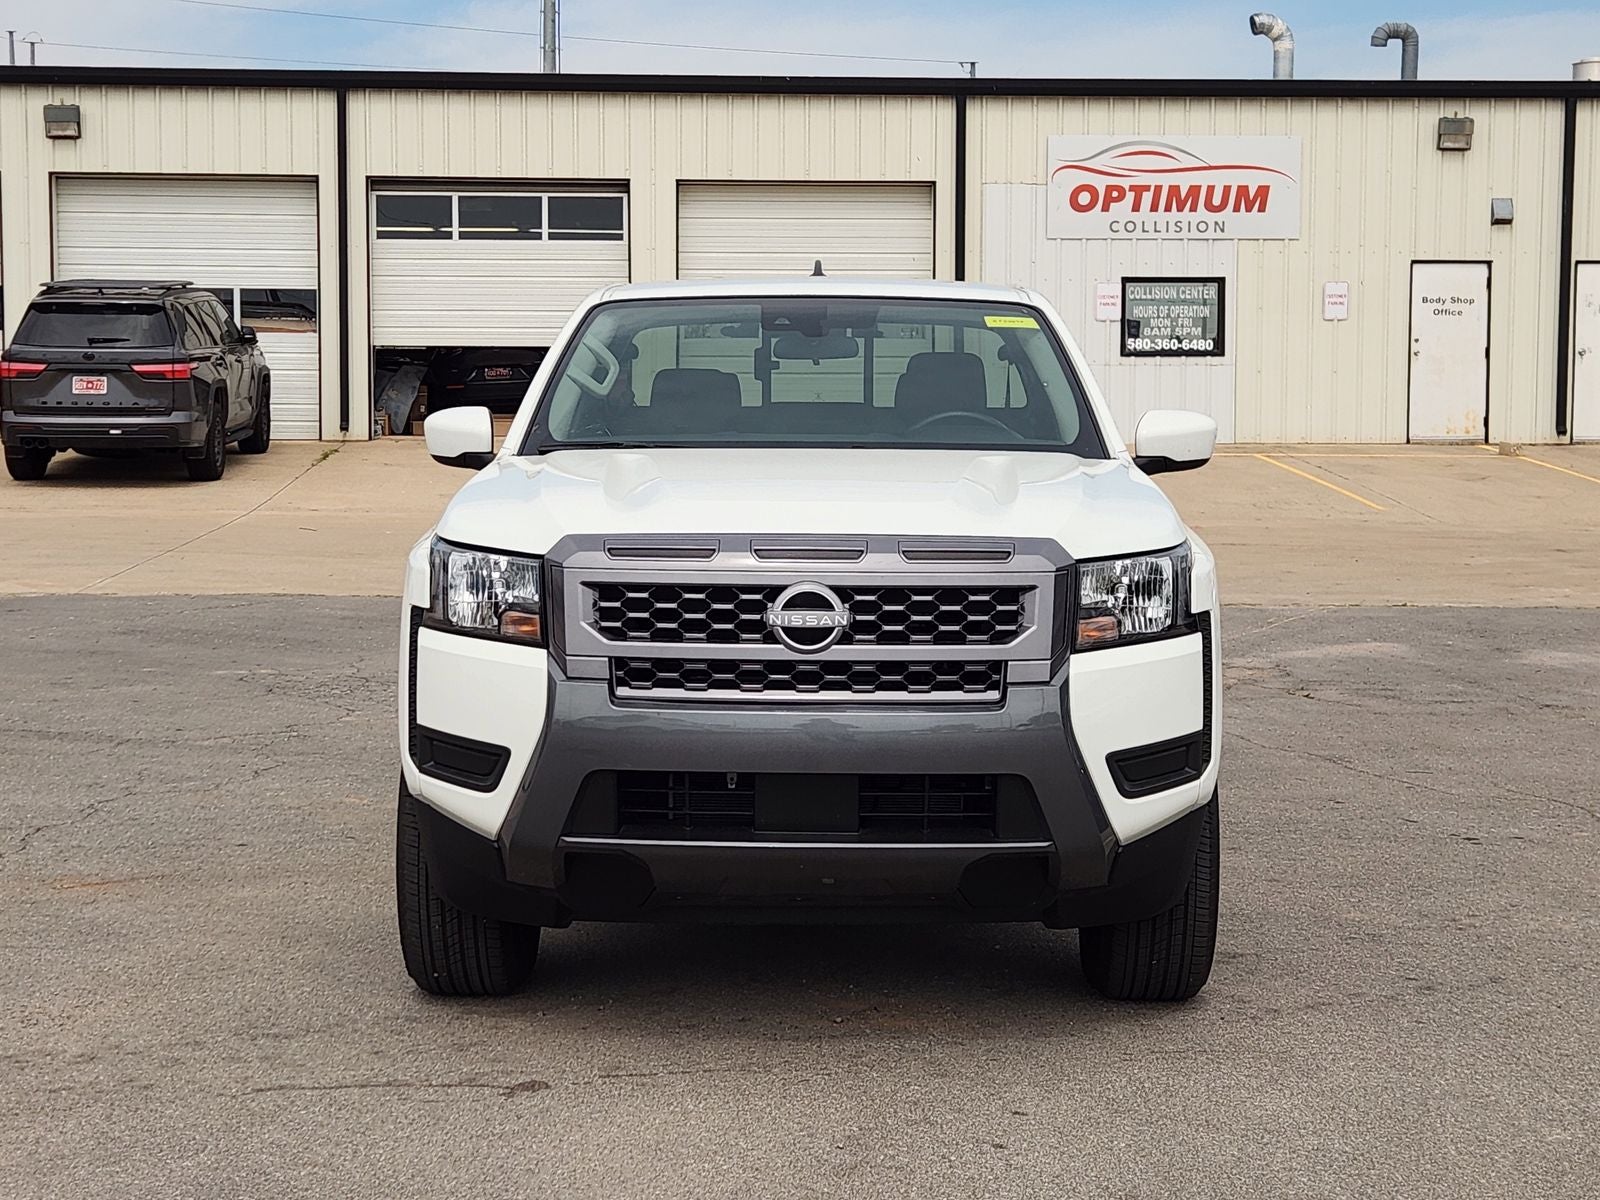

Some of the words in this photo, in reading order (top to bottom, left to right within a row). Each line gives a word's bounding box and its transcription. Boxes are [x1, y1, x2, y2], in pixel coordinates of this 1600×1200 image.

[1069, 183, 1271, 214] OPTIMUM
[1109, 220, 1226, 234] COLLISION
[1128, 286, 1177, 299] COLLISION
[1179, 286, 1216, 299] CENTER
[1422, 296, 1447, 305] Body
[1450, 296, 1475, 305] Shop
[1133, 305, 1158, 318] HOURS
[1159, 305, 1169, 318] OF
[1170, 305, 1210, 318] OPERATION
[1433, 308, 1463, 316] Office
[1150, 318, 1171, 327] MON
[1178, 318, 1193, 327] FRI
[1143, 327, 1171, 336] 8AM
[1175, 327, 1201, 336] 5PM
[1127, 338, 1214, 351] 580-360-6480
[769, 614, 847, 625] NISSAN
